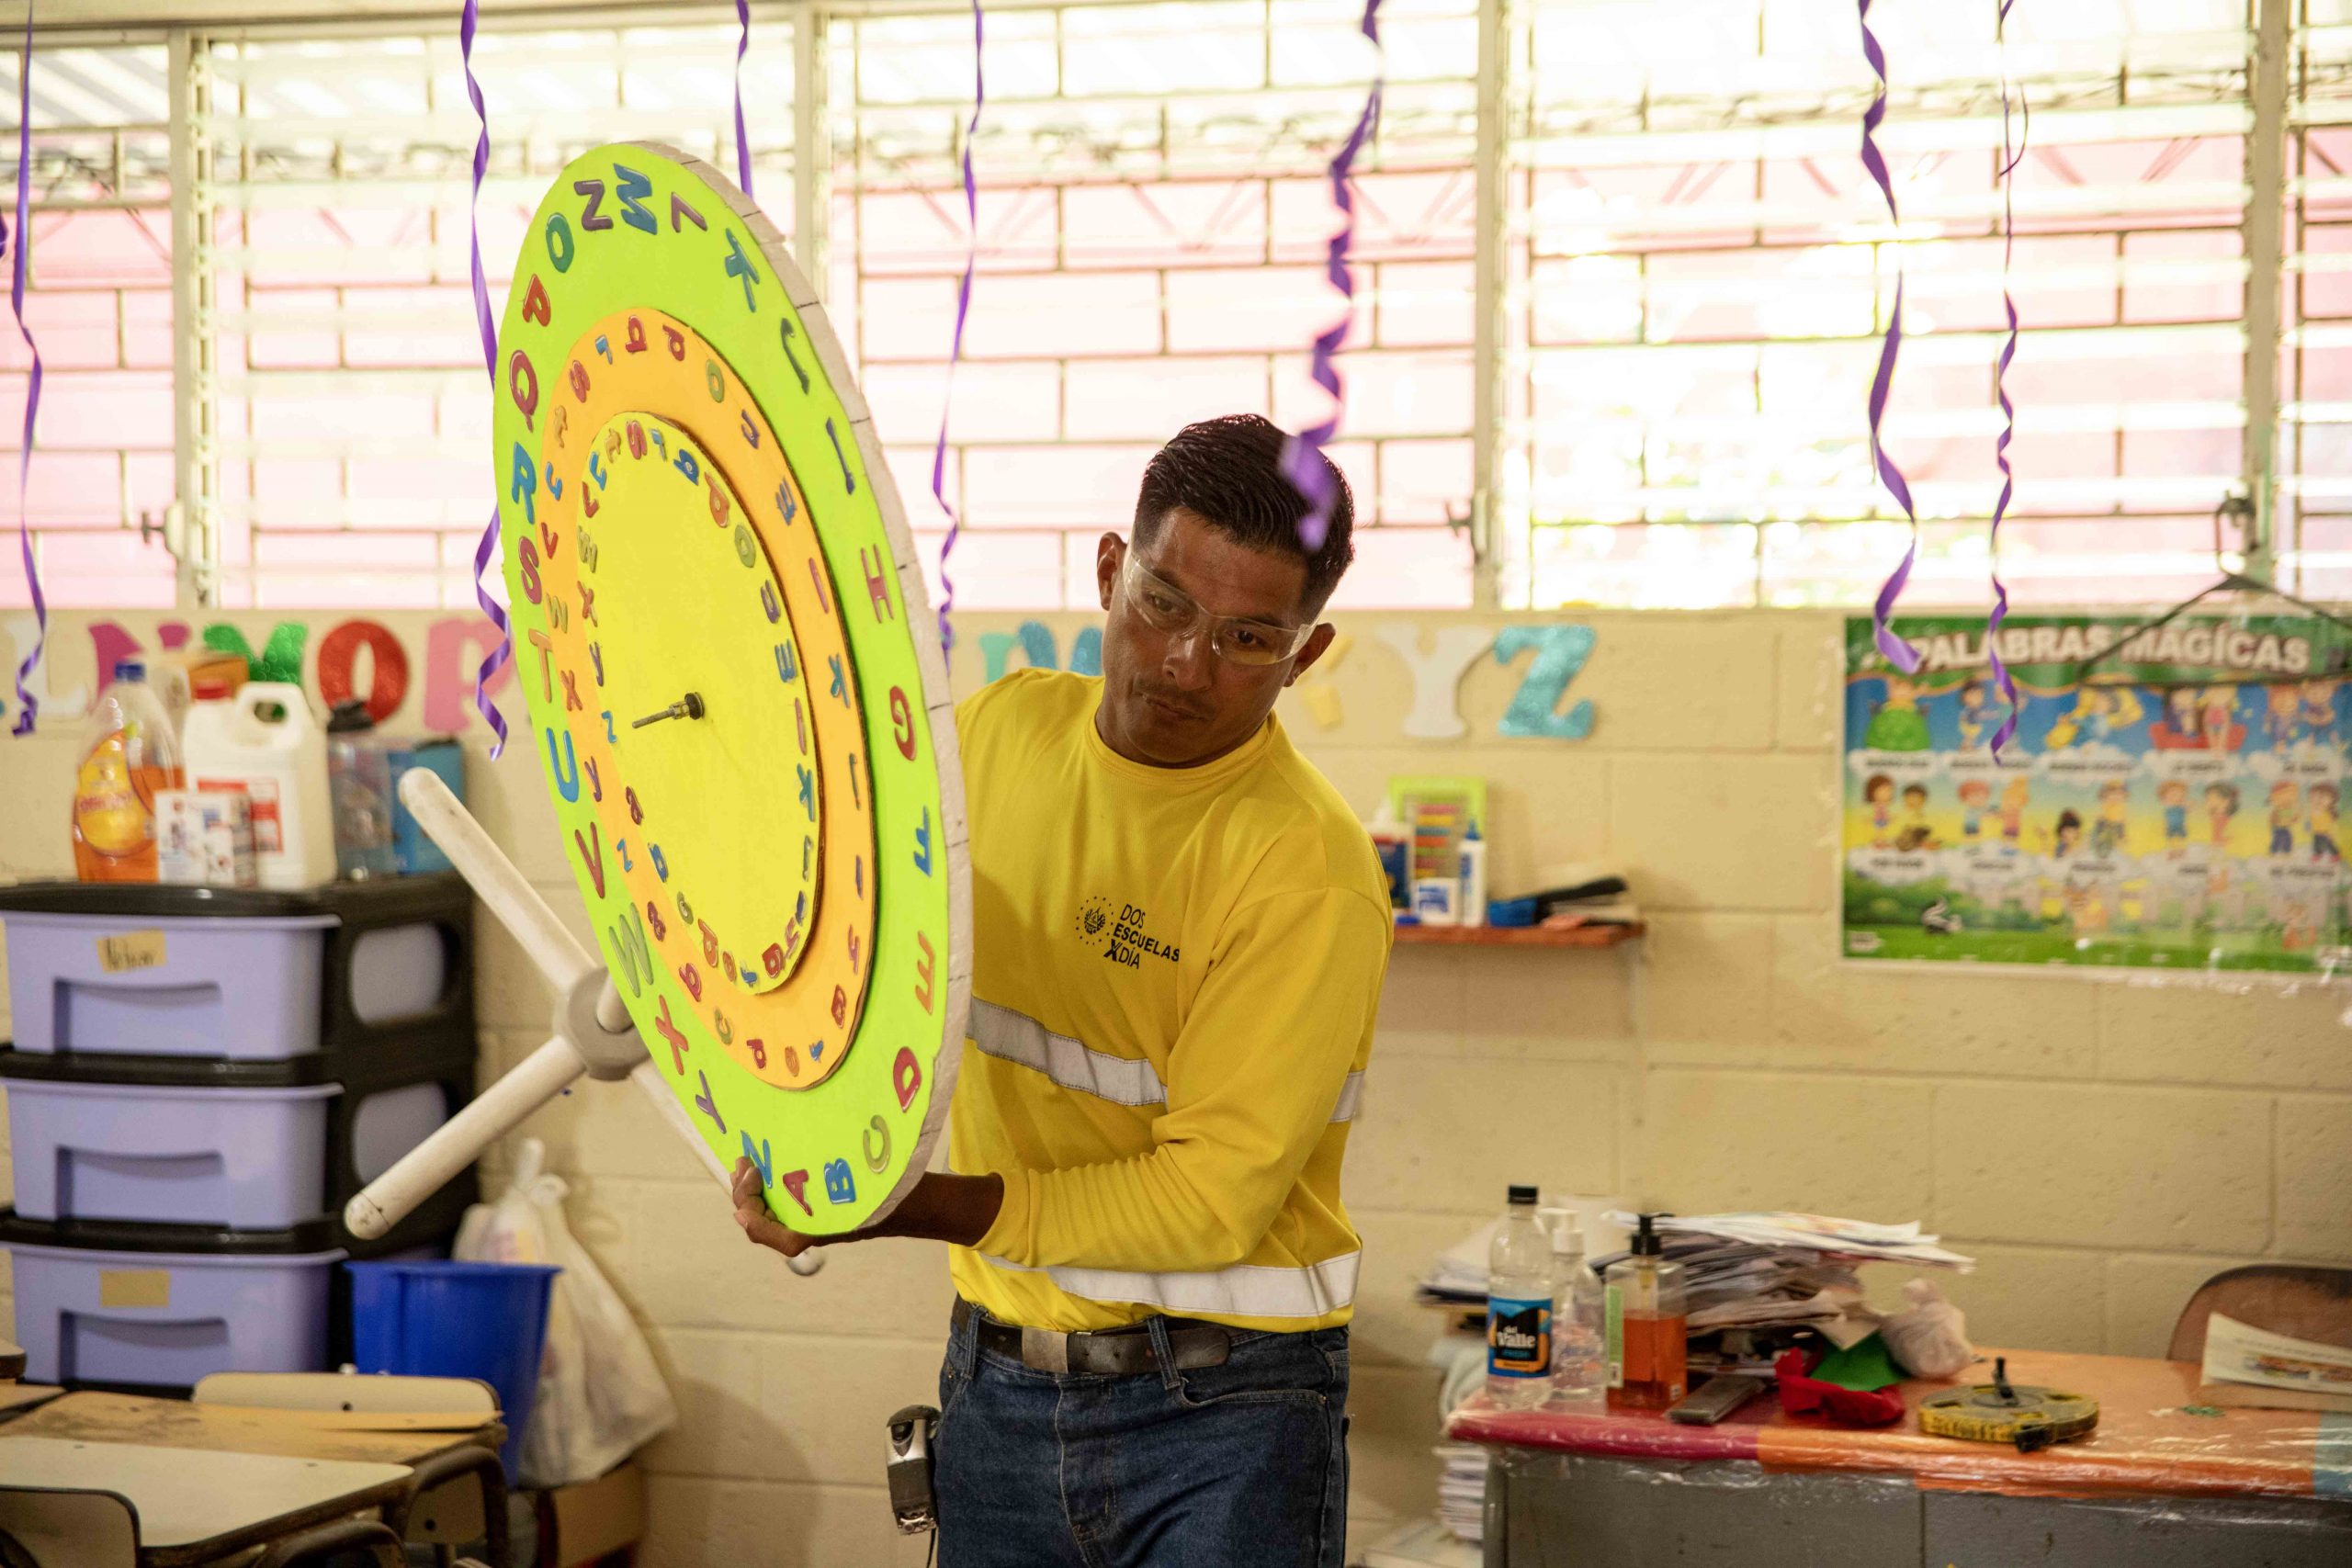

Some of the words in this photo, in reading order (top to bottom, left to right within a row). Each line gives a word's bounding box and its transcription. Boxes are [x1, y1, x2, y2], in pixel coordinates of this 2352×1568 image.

[573, 179, 614, 232] N
[612, 163, 658, 235] M
[670, 192, 707, 234] L
[545, 212, 574, 273] O
[724, 228, 760, 313] K
[522, 273, 551, 327] P
[509, 349, 539, 433] Q
[780, 317, 809, 395] J
[511, 441, 537, 525] R
[825, 417, 855, 495] I
[518, 536, 542, 606] S
[860, 544, 895, 624] H
[317, 618, 409, 727] O
[423, 617, 515, 731] P
[528, 628, 553, 704] T
[1375, 622, 1493, 739] Y
[1493, 623, 1597, 739] Z
[889, 685, 917, 761] G
[546, 727, 580, 804] U
[574, 821, 605, 899] V
[912, 806, 933, 878] F
[608, 901, 654, 998] W
[1113, 923, 1180, 962] ESCUELAS
[1120, 904, 1146, 929] DOS
[915, 931, 934, 1014] E
[654, 994, 689, 1076] X
[695, 1069, 727, 1134] Y
[892, 1046, 922, 1113] D
[741, 1129, 773, 1189] Z
[863, 1114, 891, 1174] C
[782, 1169, 814, 1217] A
[823, 1157, 856, 1205] B
[1497, 1332, 1536, 1348] Valle
